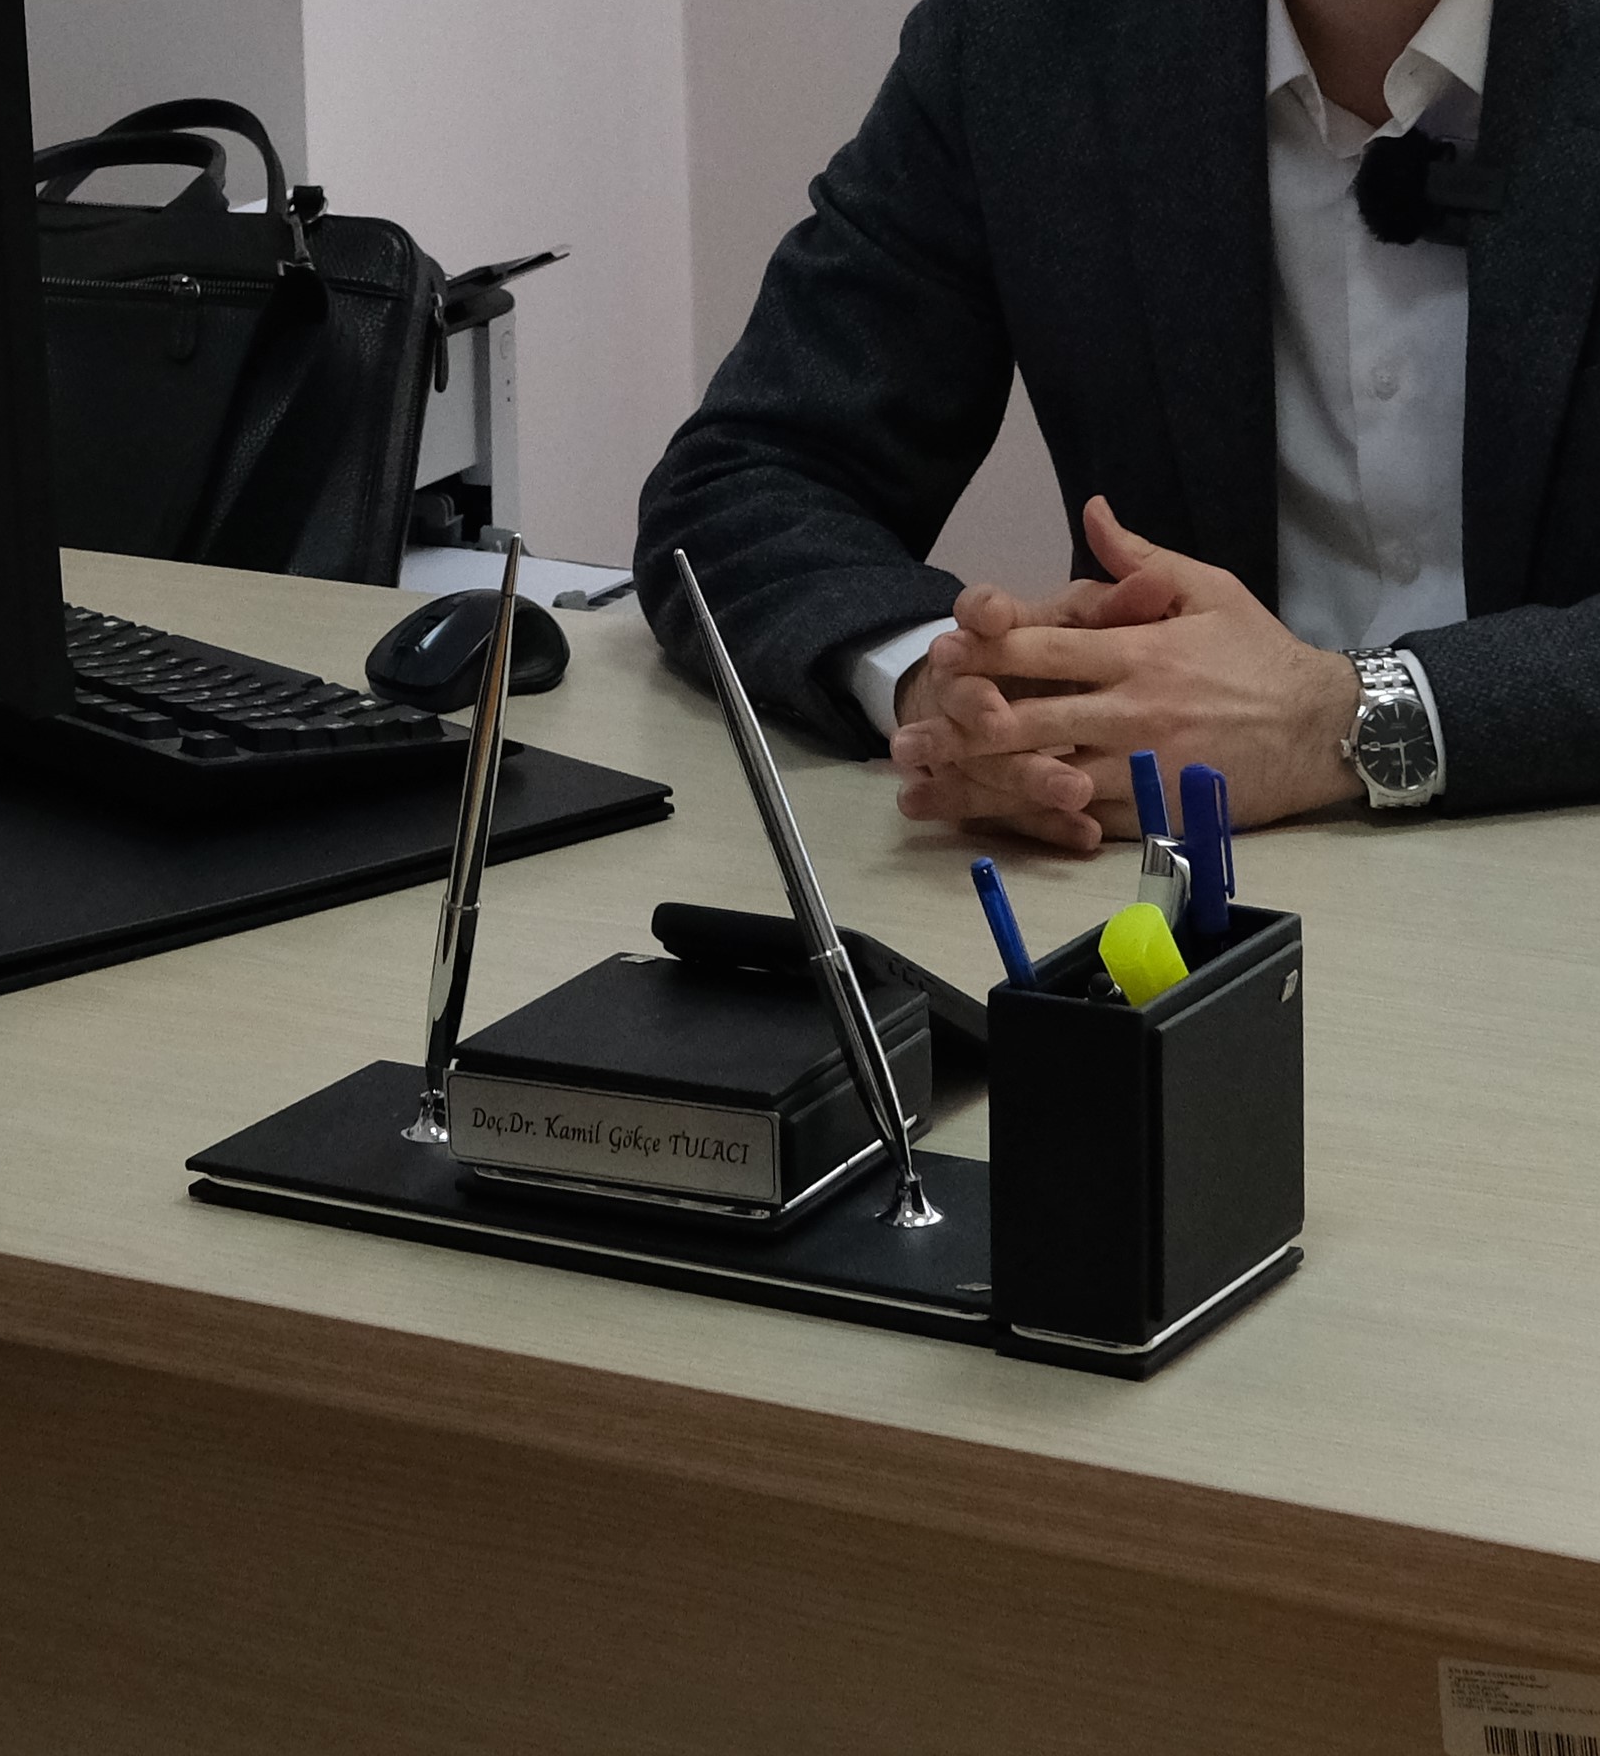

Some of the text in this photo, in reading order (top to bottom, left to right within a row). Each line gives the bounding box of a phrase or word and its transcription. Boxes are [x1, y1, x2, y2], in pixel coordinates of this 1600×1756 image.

[544, 1115, 603, 1145] Kamil
[608, 1125, 661, 1156] Gökçe
[669, 1131, 750, 1164] TULACI
